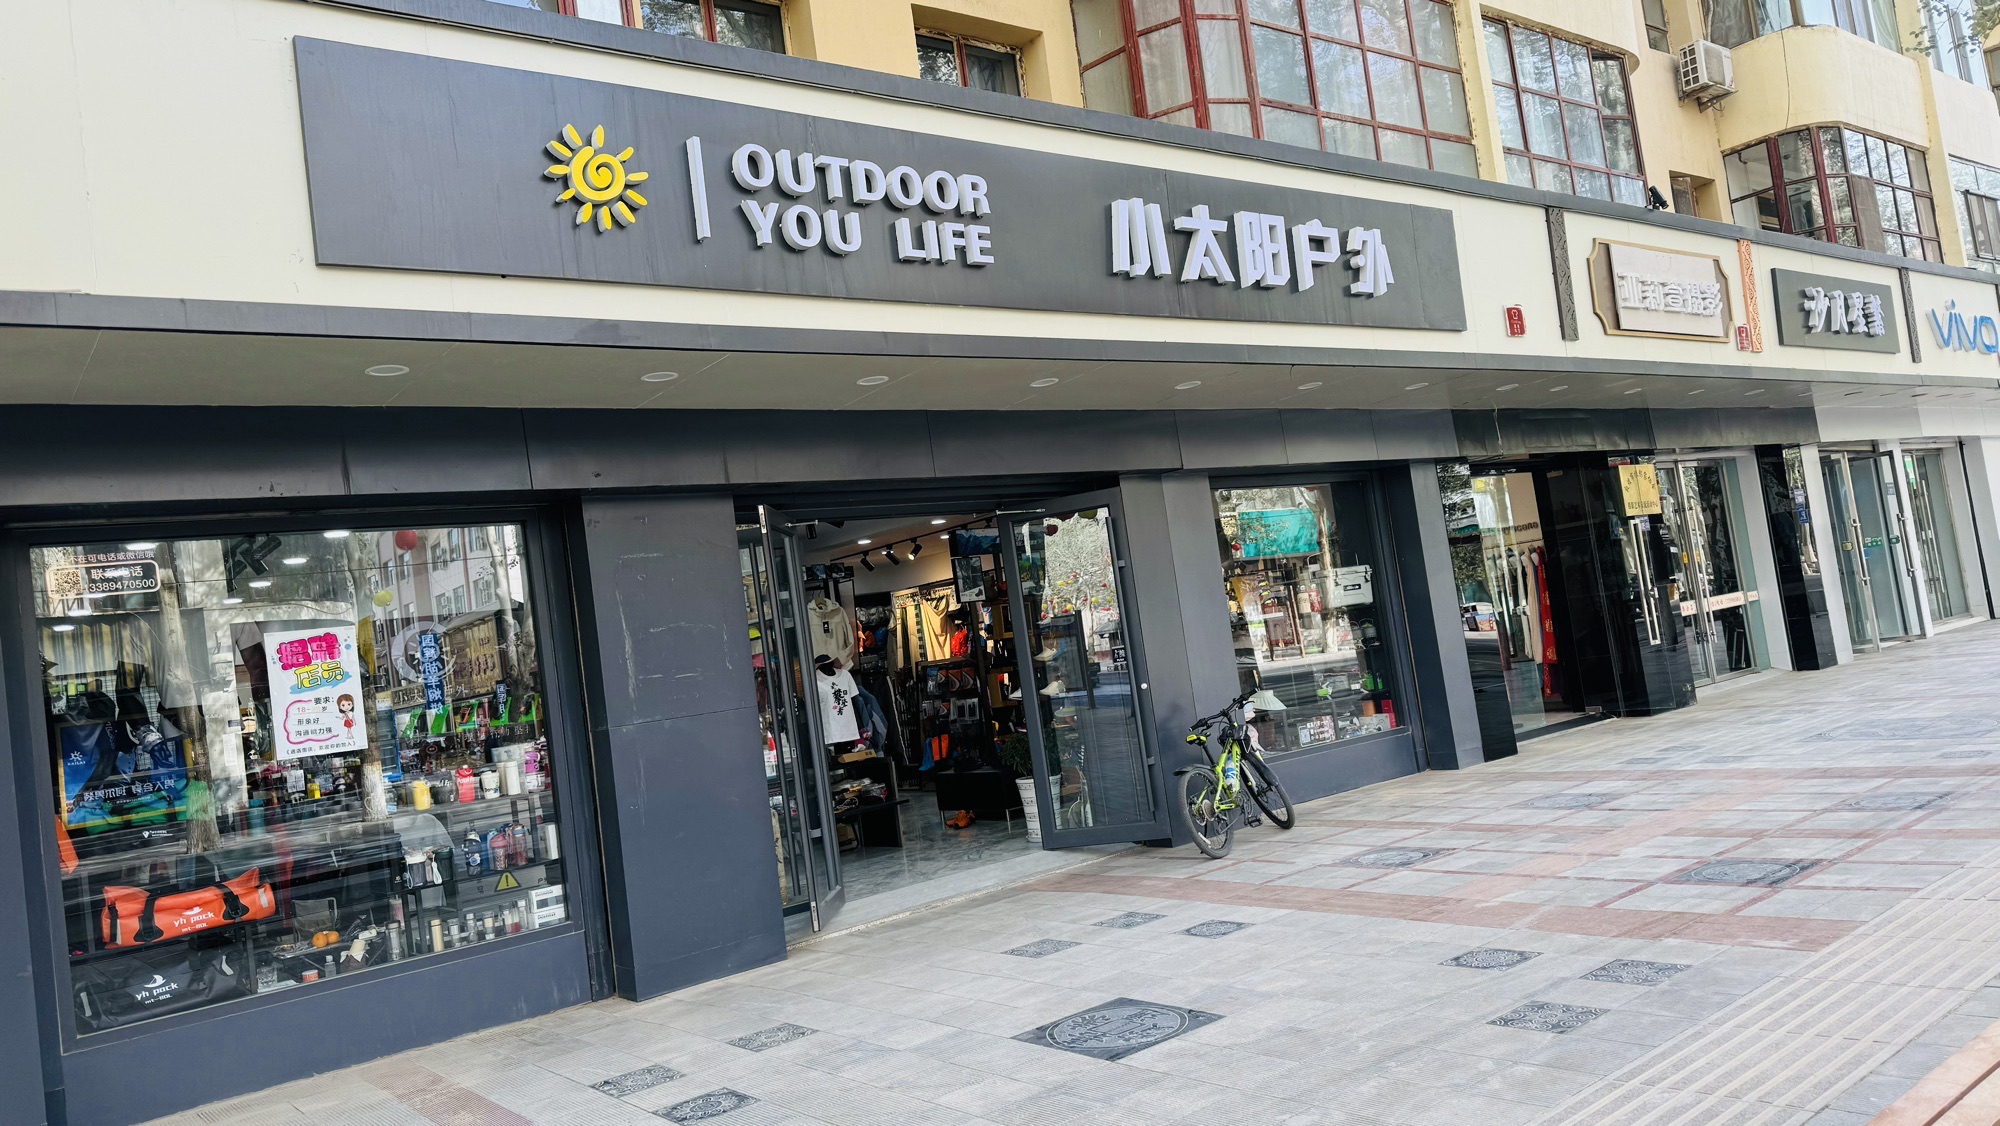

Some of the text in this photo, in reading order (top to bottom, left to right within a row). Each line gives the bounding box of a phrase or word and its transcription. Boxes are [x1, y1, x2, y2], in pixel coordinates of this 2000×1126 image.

[731, 143, 991, 216] OUTDOOR
[740, 199, 995, 265] YOU LIFE
[1111, 197, 1394, 297] 小太阳户外
[1926, 299, 1999, 354] vivo
[91, 565, 143, 580] 联系电话
[277, 632, 341, 670] 招聘
[294, 661, 344, 689] 店员
[173, 911, 214, 927] yh pack
[135, 982, 179, 1001] yh pack
